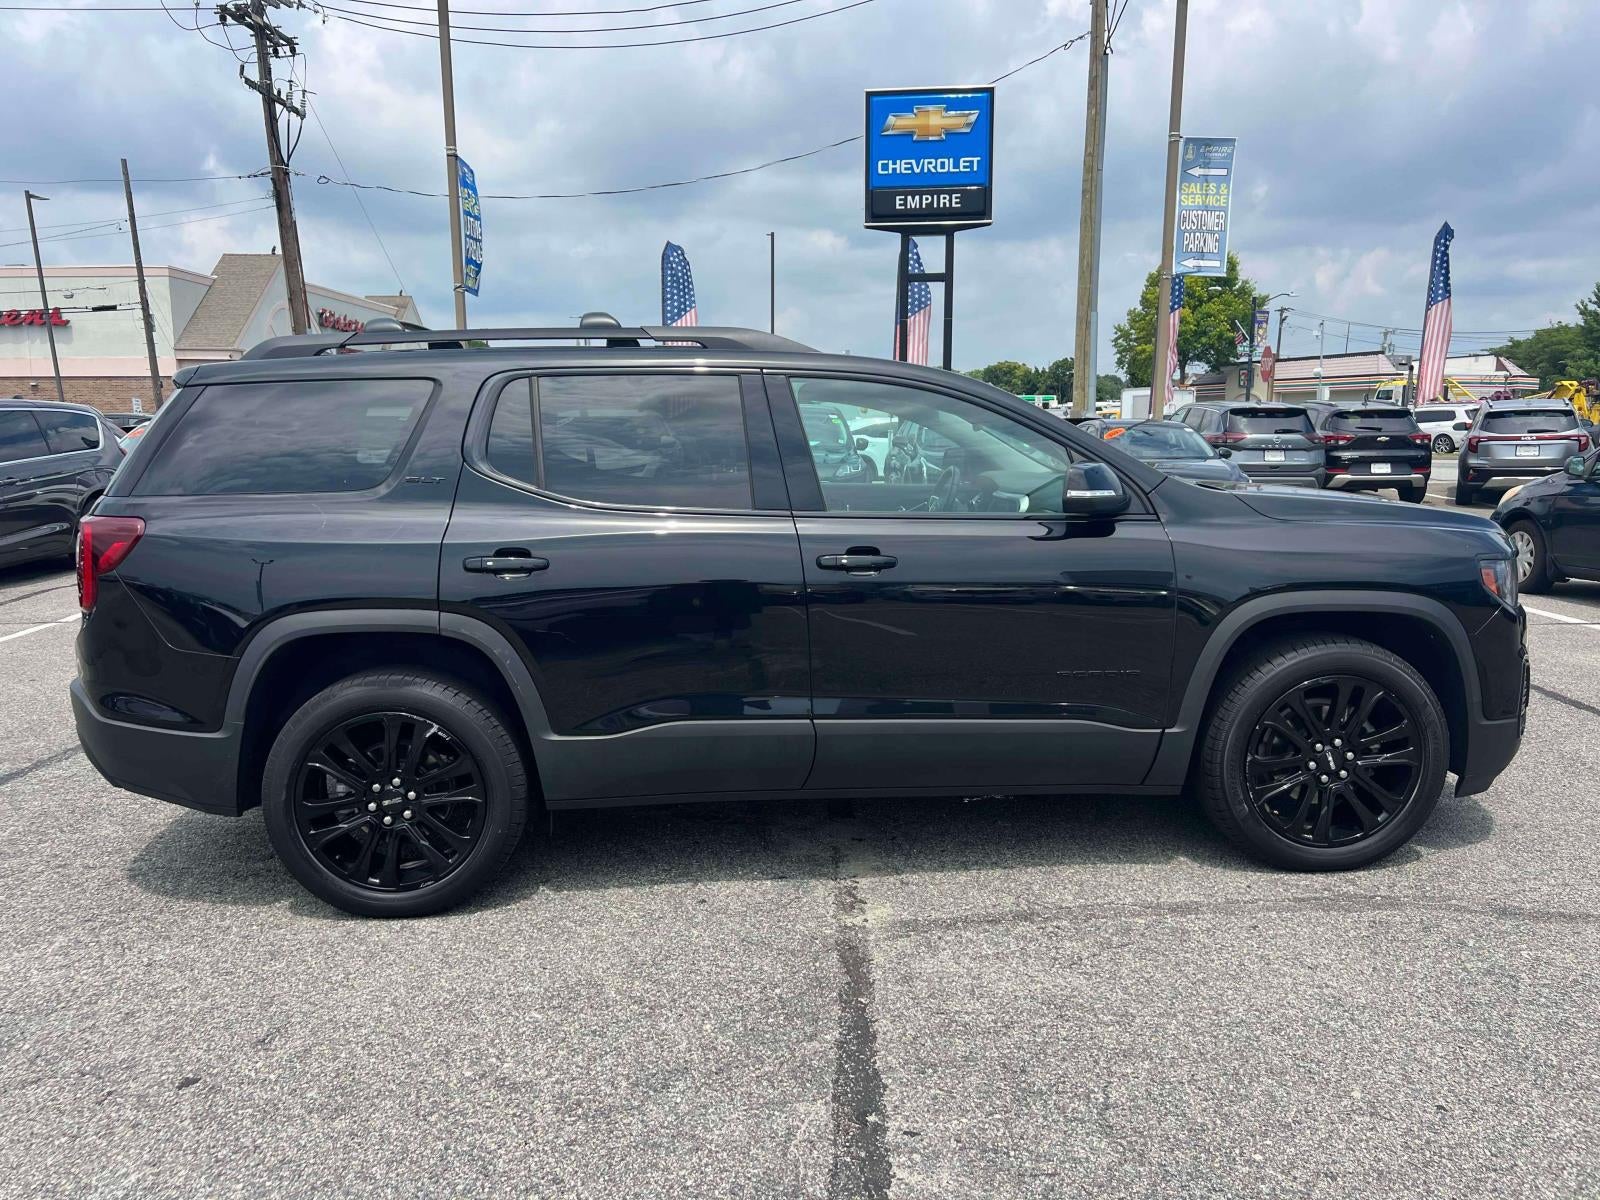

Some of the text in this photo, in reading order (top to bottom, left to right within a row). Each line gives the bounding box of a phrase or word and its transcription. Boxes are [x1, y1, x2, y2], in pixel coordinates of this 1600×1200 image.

[1200, 145, 1233, 153] EMPIRE
[877, 157, 981, 175] CHEVROLET
[1181, 183, 1229, 194] SALES &
[895, 193, 961, 210] EMPIRE
[1180, 194, 1228, 206] SERVICE
[1180, 209, 1226, 230] CUSTOMER
[1183, 232, 1219, 253] PARKING
